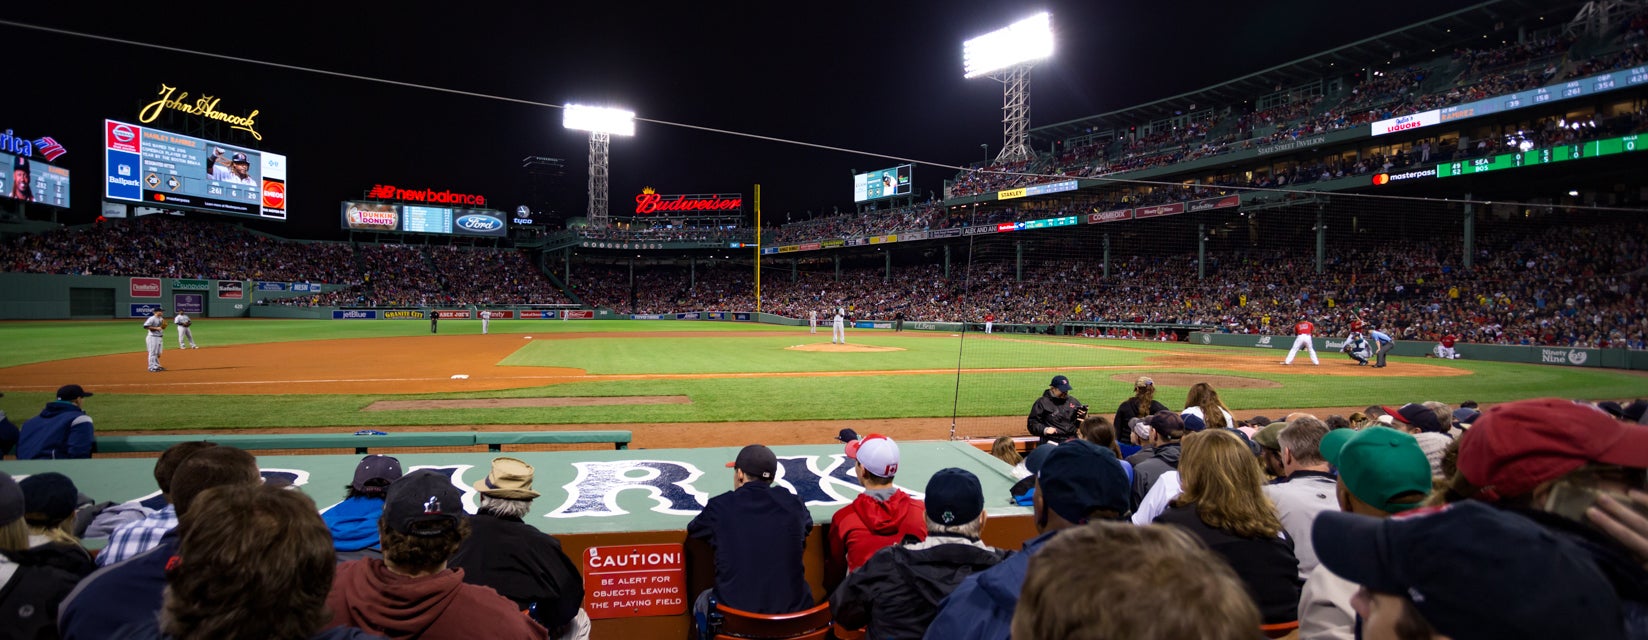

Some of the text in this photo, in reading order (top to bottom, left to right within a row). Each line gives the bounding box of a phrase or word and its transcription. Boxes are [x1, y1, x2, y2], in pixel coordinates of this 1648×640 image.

[139, 83, 262, 140] John Hancock
[1388, 120, 1421, 132] LIQUORS
[1476, 164, 1488, 172] BOS
[109, 176, 140, 186] Ballpark
[1390, 168, 1436, 182] masterpass
[396, 188, 427, 202] new
[427, 188, 485, 206] balance
[1000, 190, 1022, 198] STANLEY
[636, 194, 742, 214] Budweiser
[1092, 211, 1125, 221] COGMEDIX
[465, 216, 494, 230] Ford
[1542, 354, 1566, 362] Nine
[589, 552, 681, 568] CAUTION!
[618, 576, 647, 584] ALERT
[593, 586, 678, 598] OBJECTS LEAVING
[614, 598, 652, 608] PLAYING
